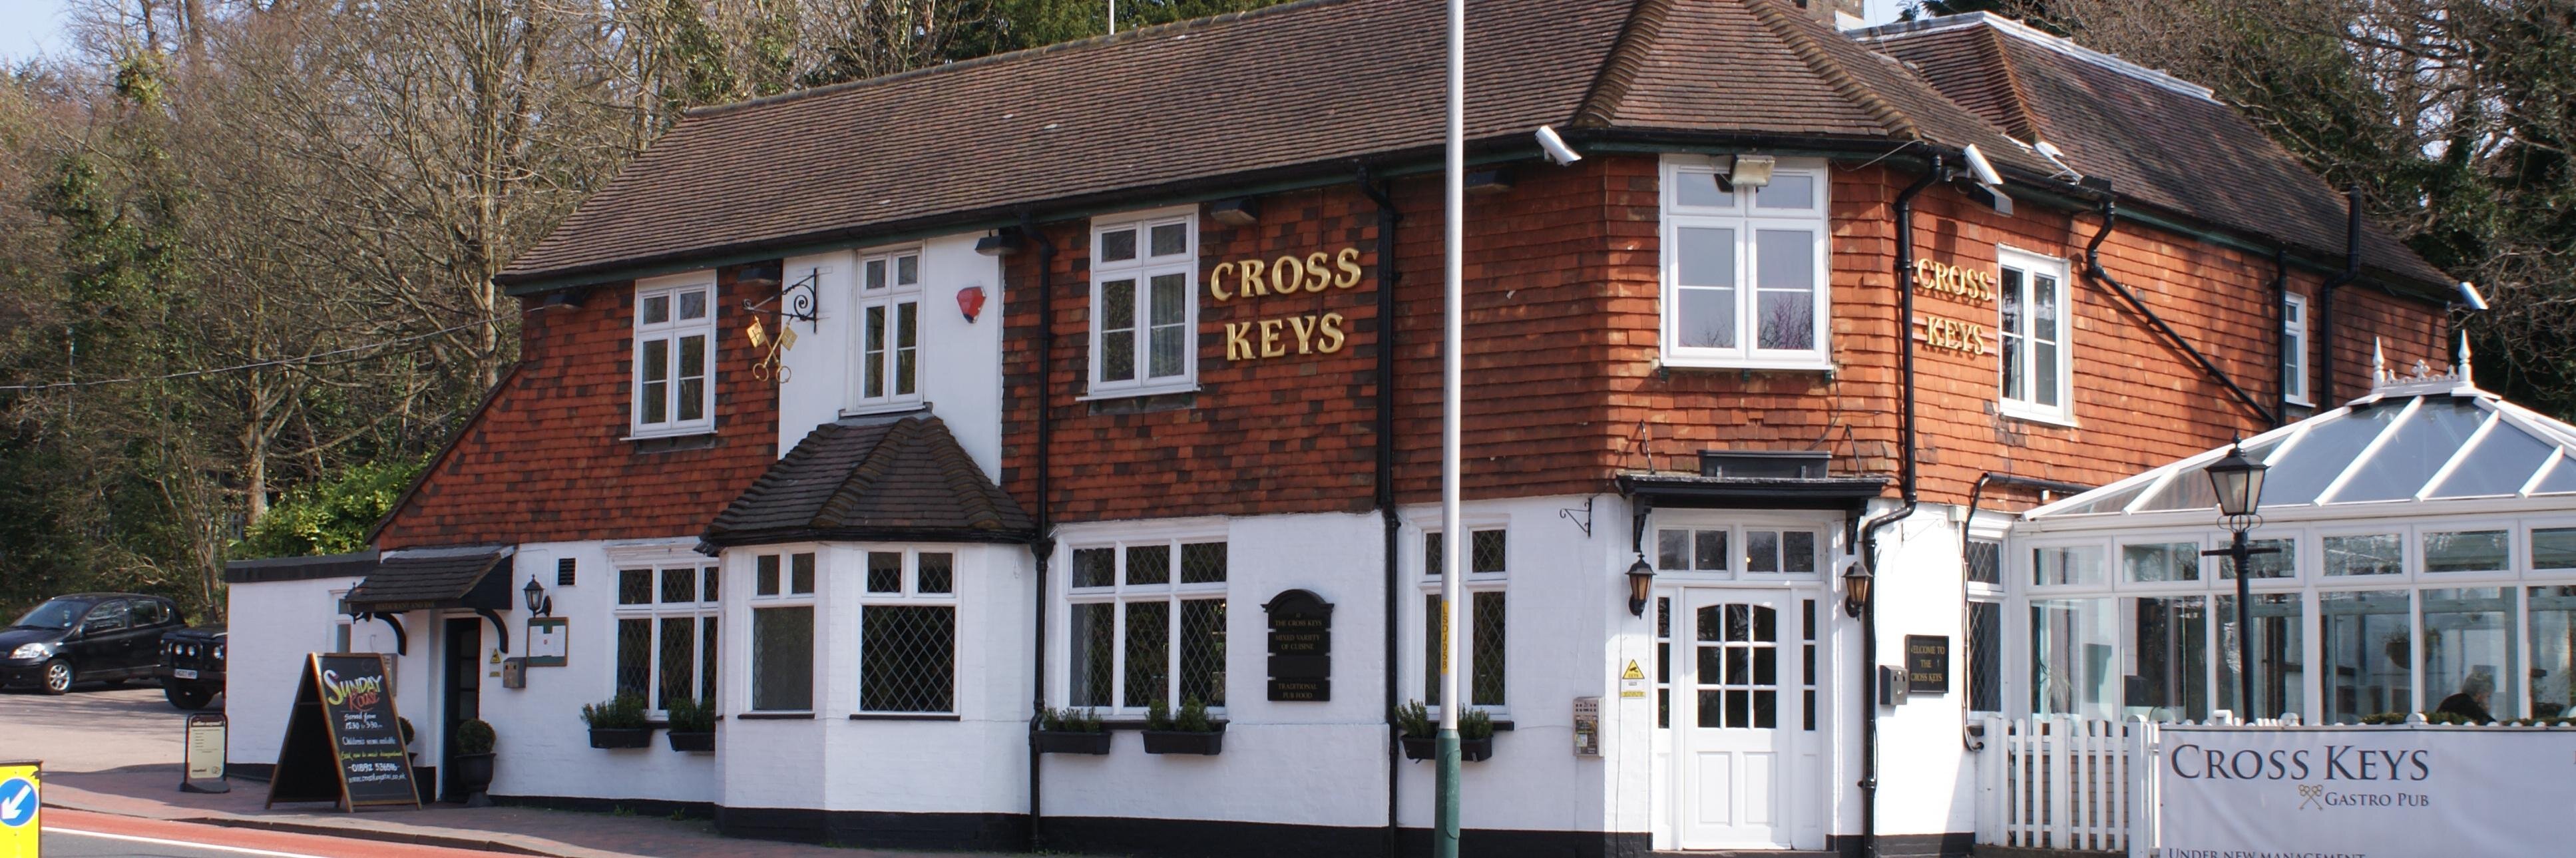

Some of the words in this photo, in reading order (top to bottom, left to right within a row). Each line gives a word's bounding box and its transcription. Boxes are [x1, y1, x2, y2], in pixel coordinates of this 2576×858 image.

[1211, 248, 1361, 301] CROSS
[1918, 258, 1990, 301] CROSS
[1225, 313, 1345, 361] KEYS
[1926, 316, 1984, 355] KEYS
[1937, 645, 1945, 654] TO
[323, 670, 383, 706] SUNDAY
[1911, 673, 1928, 682] CROSS
[1928, 673, 1942, 682] KEYS
[2171, 744, 2309, 780] CROSS
[2324, 745, 2429, 781] KEYS
[2325, 791, 2391, 806] GASTRO
[2398, 792, 2429, 807] PUB
[2169, 848, 2218, 858] UNDER
